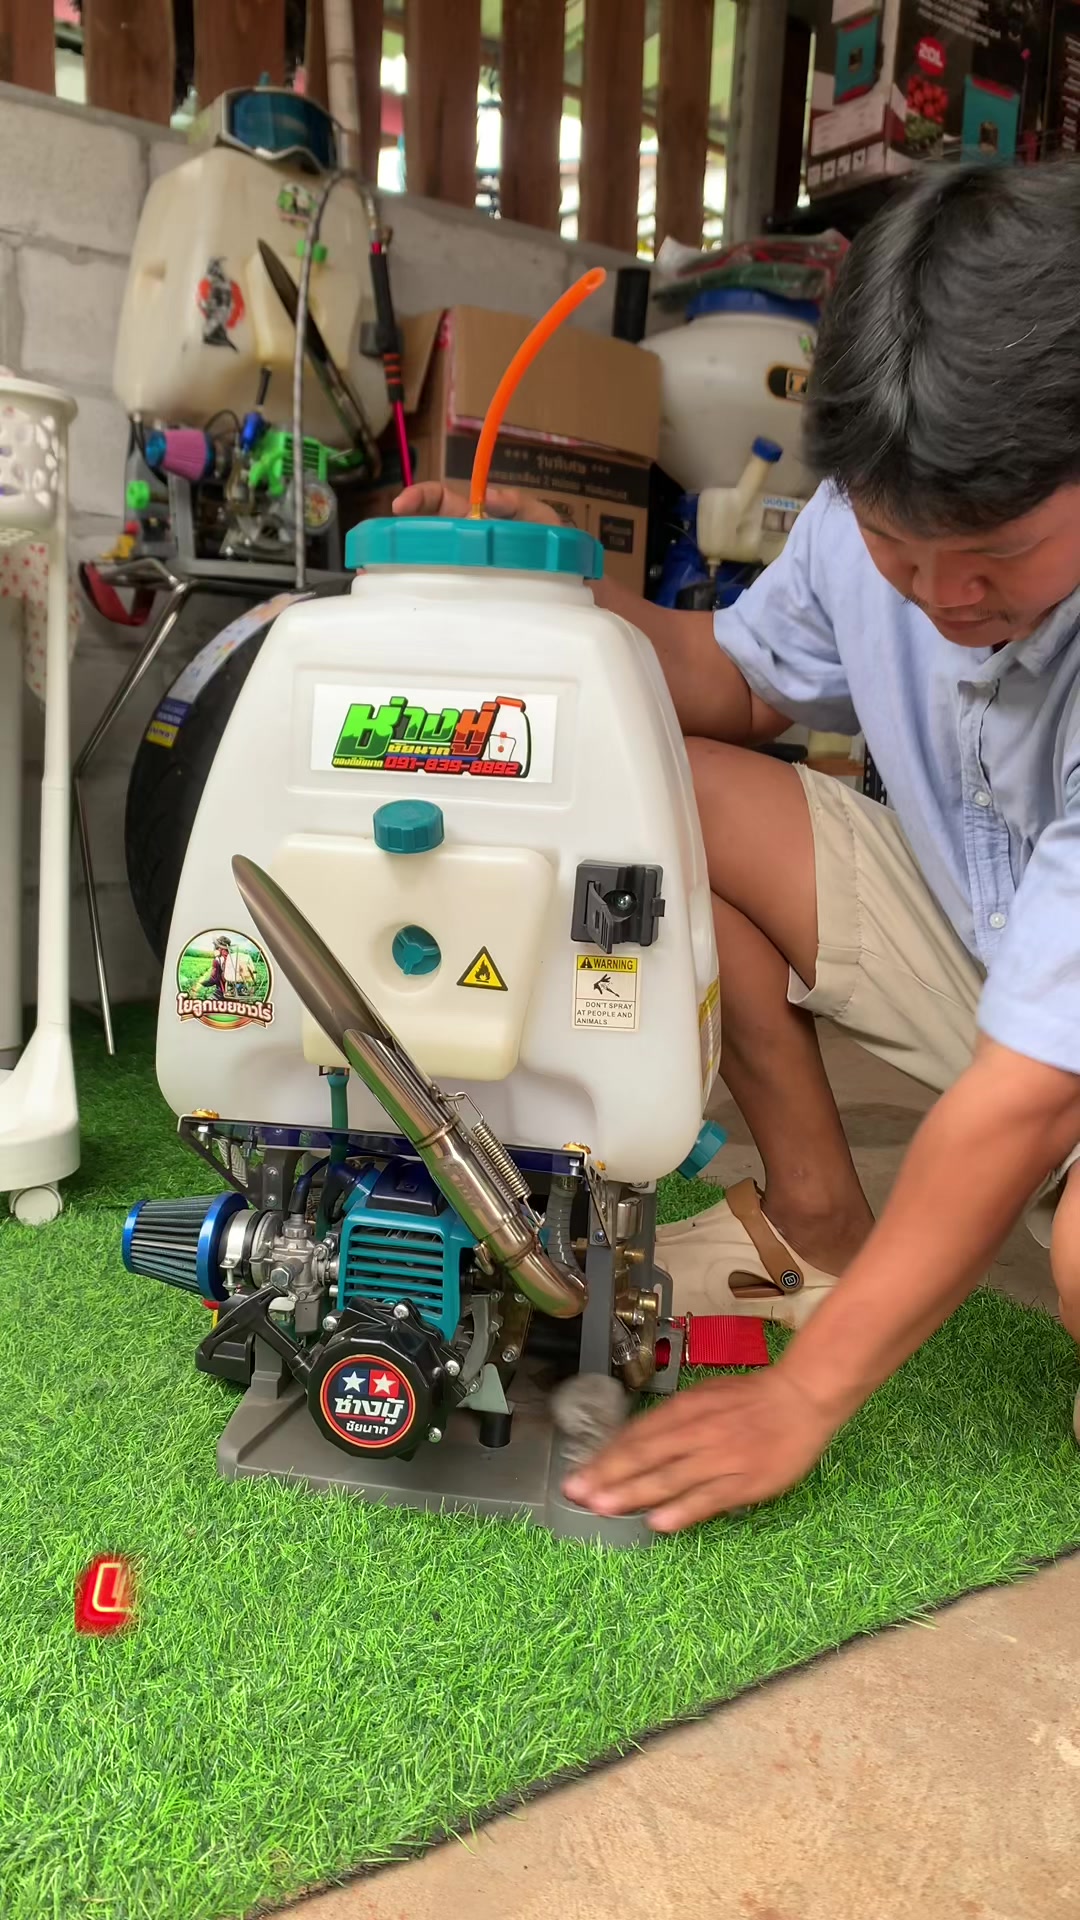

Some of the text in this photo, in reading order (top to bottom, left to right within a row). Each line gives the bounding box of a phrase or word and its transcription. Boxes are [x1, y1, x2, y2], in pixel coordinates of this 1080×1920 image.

[387, 743, 451, 756] ชัยนาท
[384, 757, 520, 775] 091-839-8892
[593, 958, 633, 970] WARNING
[586, 1001, 632, 1010] DON'T SPRAY
[587, 1010, 615, 1018] PEOPLE
[577, 1017, 608, 1025] ANIMALS
[346, 1420, 389, 1435] ชัยนาท
